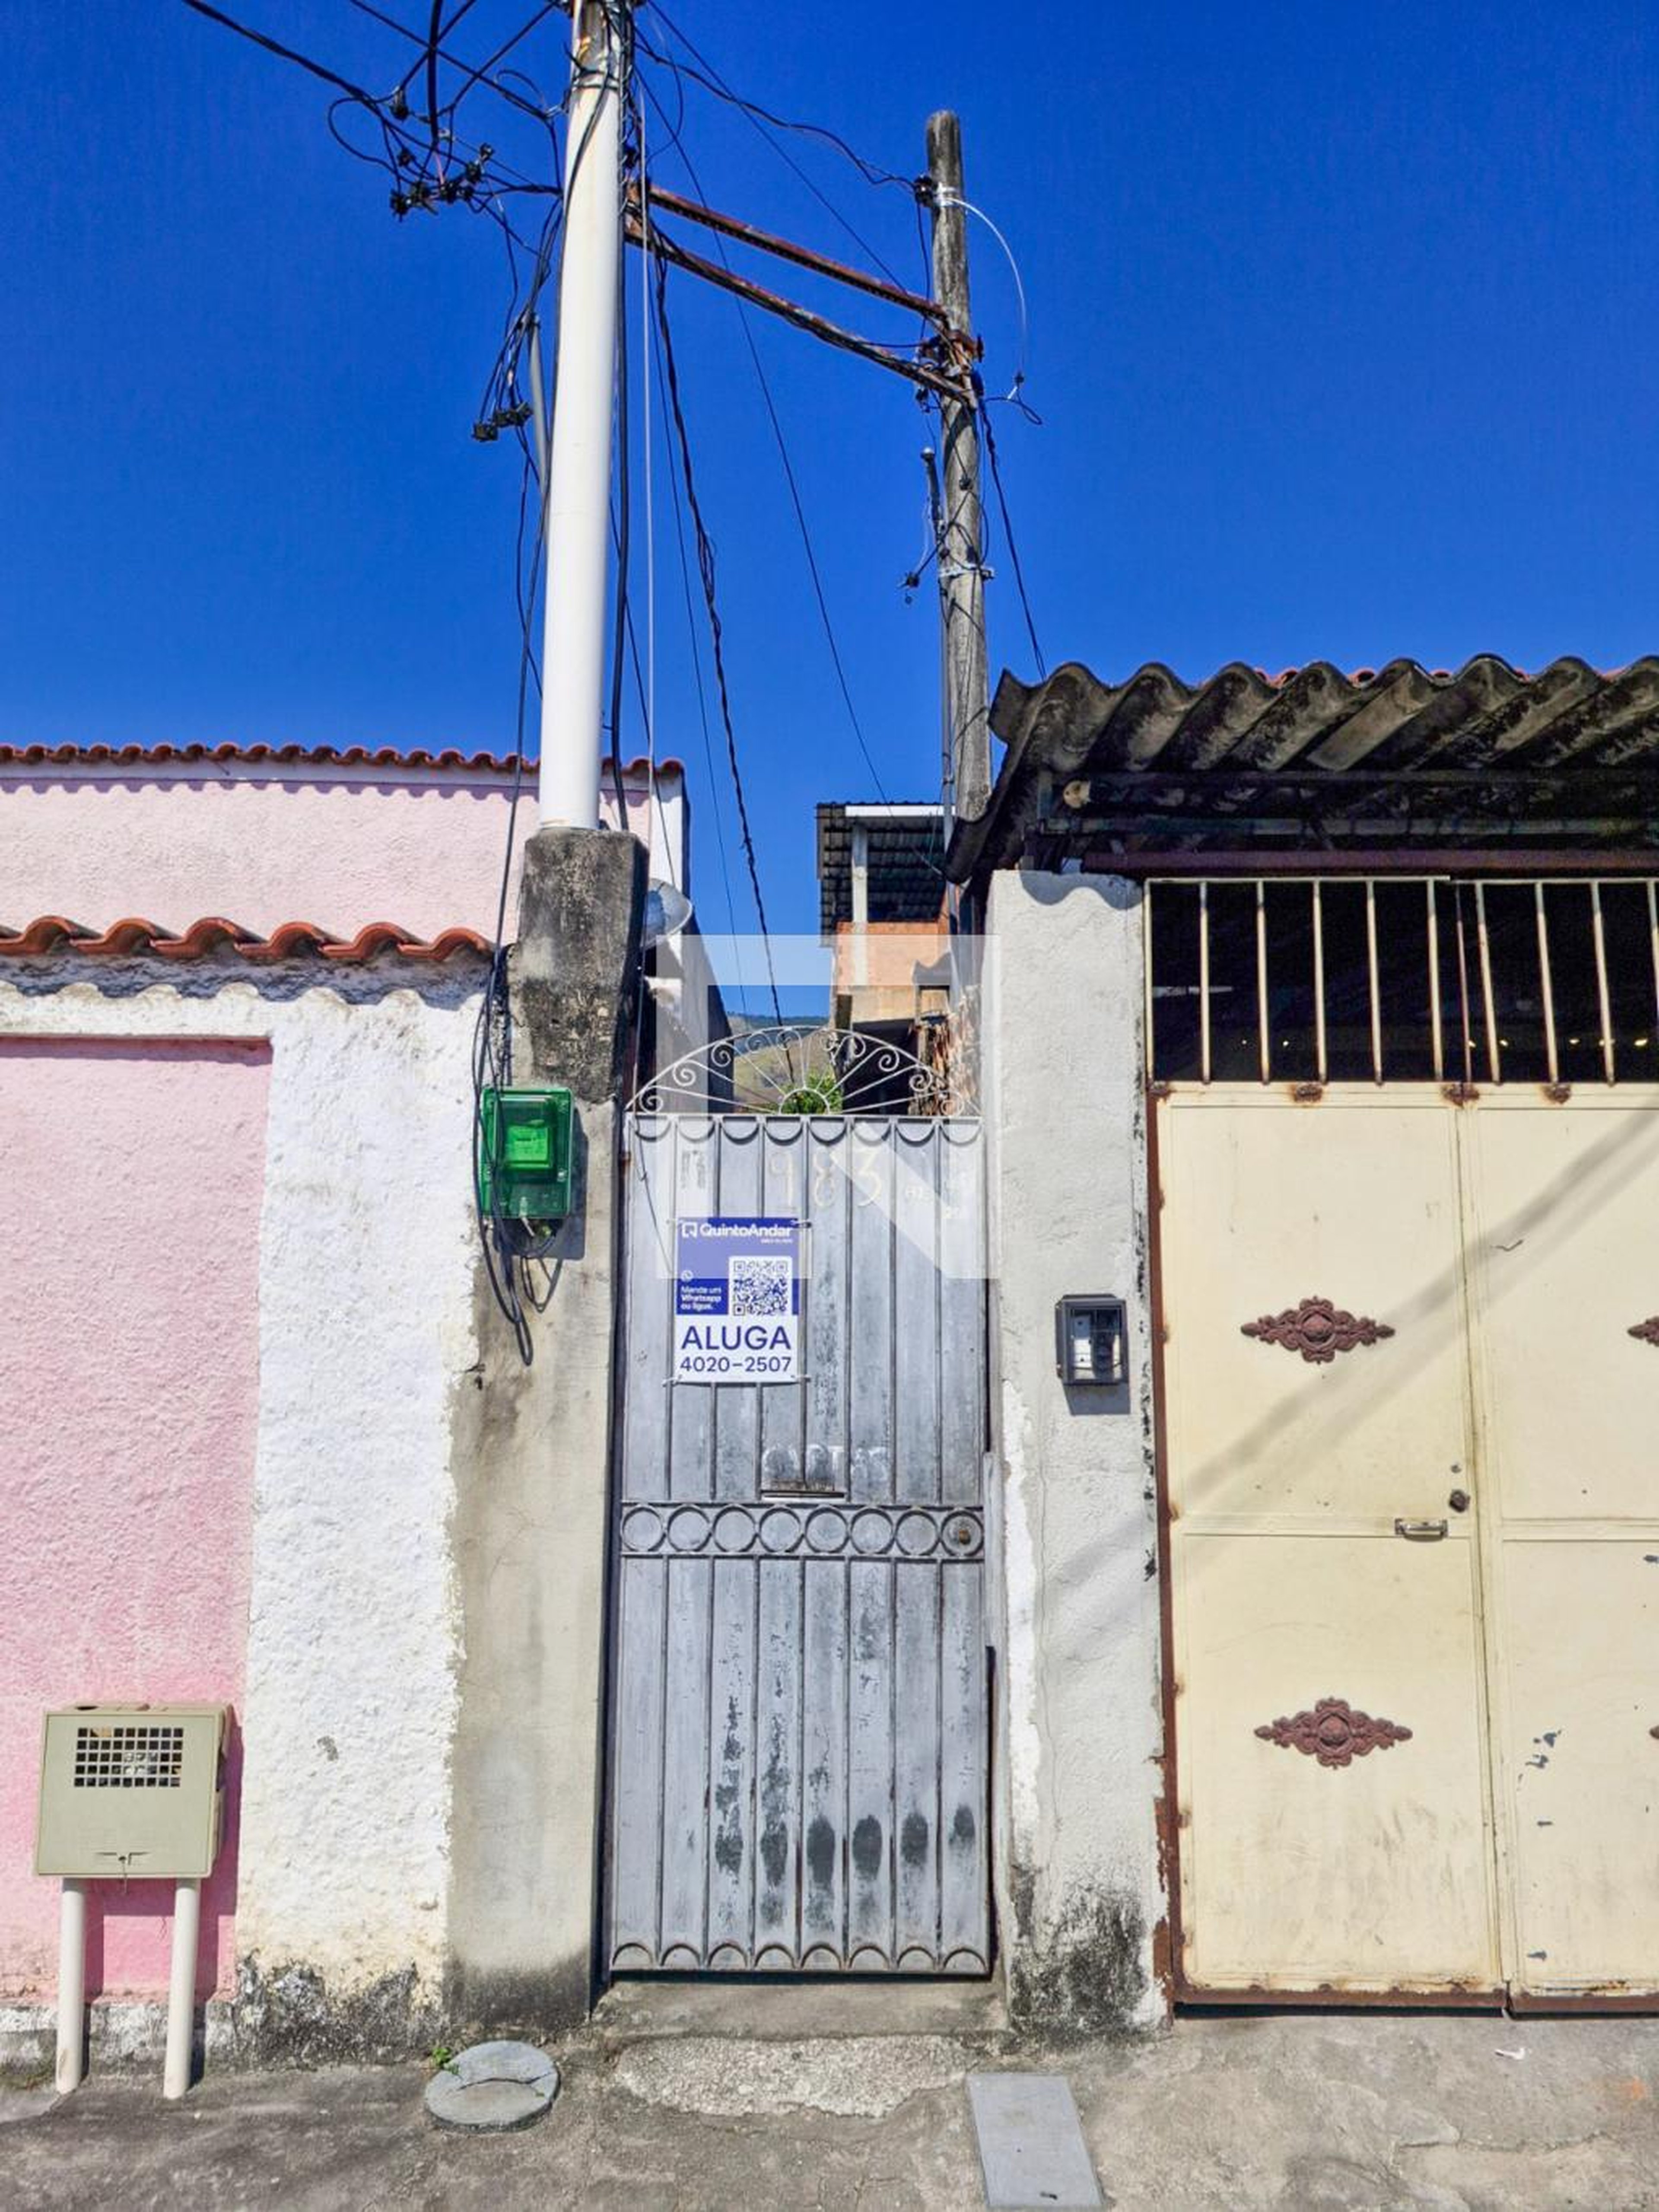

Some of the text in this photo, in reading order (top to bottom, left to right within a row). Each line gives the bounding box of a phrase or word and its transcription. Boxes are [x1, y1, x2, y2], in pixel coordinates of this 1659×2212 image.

[770, 1146, 881, 1207] 983
[699, 1222, 793, 1237] QuintoAndar
[681, 1326, 791, 1350] ALUGA
[680, 1356, 791, 1372] 4020-2507
